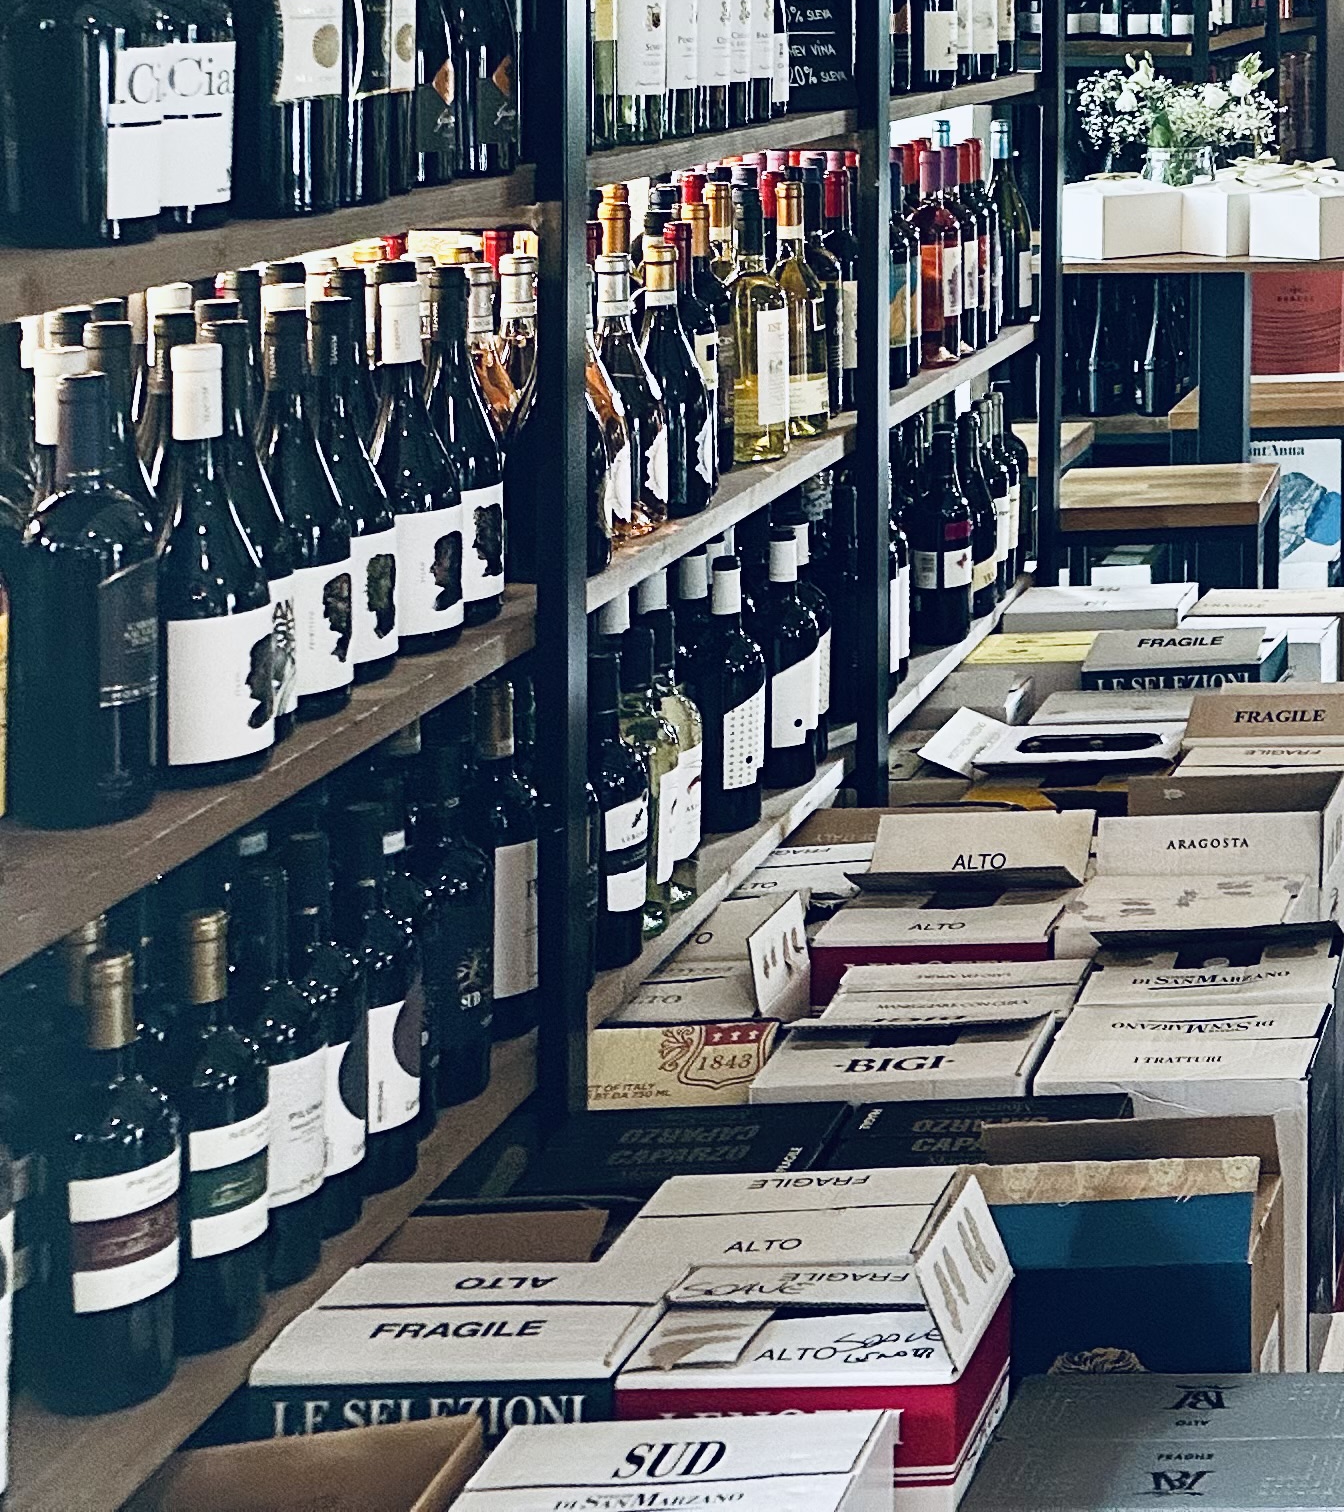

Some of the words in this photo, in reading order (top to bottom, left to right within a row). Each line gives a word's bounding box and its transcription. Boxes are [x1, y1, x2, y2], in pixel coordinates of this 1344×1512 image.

[1137, 635, 1225, 649] FRAGILE
[1233, 709, 1327, 724] FRAGILE
[1243, 748, 1322, 756] FRAGILE
[769, 846, 831, 856] FRAG
[1166, 837, 1249, 851] ARAGOSTA
[951, 853, 1006, 871] ALTO
[908, 921, 966, 931] ALTO
[697, 1053, 753, 1072] 1843
[843, 1055, 946, 1074] BIGI
[1143, 1054, 1223, 1064] TRATTURI
[608, 1145, 751, 1164] CAPARZO
[750, 1175, 871, 1190] FRAGILE
[724, 1238, 802, 1253] ALTO
[456, 1276, 558, 1290] ALTO
[779, 1271, 911, 1283] FRAGILE
[369, 1319, 549, 1339] FRAGILE
[754, 1347, 837, 1362] ALTO
[611, 1440, 727, 1479] SUD
